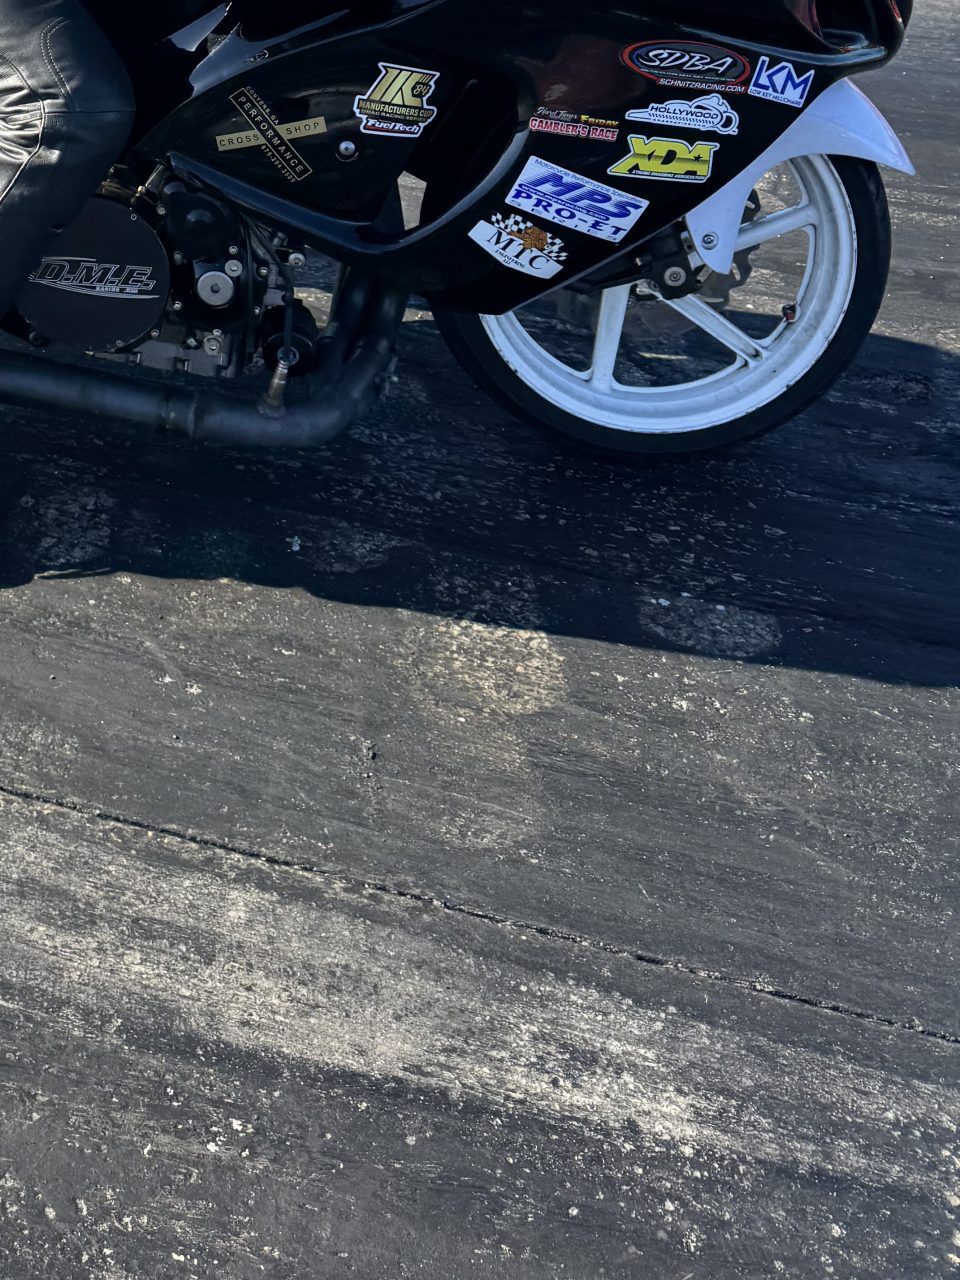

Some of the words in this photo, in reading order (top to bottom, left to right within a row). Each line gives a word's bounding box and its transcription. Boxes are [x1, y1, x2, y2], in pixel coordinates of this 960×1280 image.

[639, 49, 734, 74] SDBA
[659, 78, 745, 93] SCHNITZRACING.COM
[358, 100, 419, 117] MANUFACTURERS
[420, 109, 433, 118] CUP
[649, 105, 719, 120] HOLLYWOOD
[220, 133, 260, 147] CROSS
[286, 122, 320, 135] SHOP
[238, 96, 304, 173] PERFORMANCE
[366, 118, 419, 133] FuelTech
[529, 117, 589, 136] GAMBLER'S
[590, 126, 619, 142] RACE
[609, 137, 716, 177] XDA
[534, 158, 571, 179] Motorcycle
[571, 173, 611, 193] Performance
[520, 184, 607, 220] www.mpsracing.com
[527, 171, 643, 218] MPS
[511, 189, 628, 236] PRO-ET
[486, 229, 550, 270] MTC
